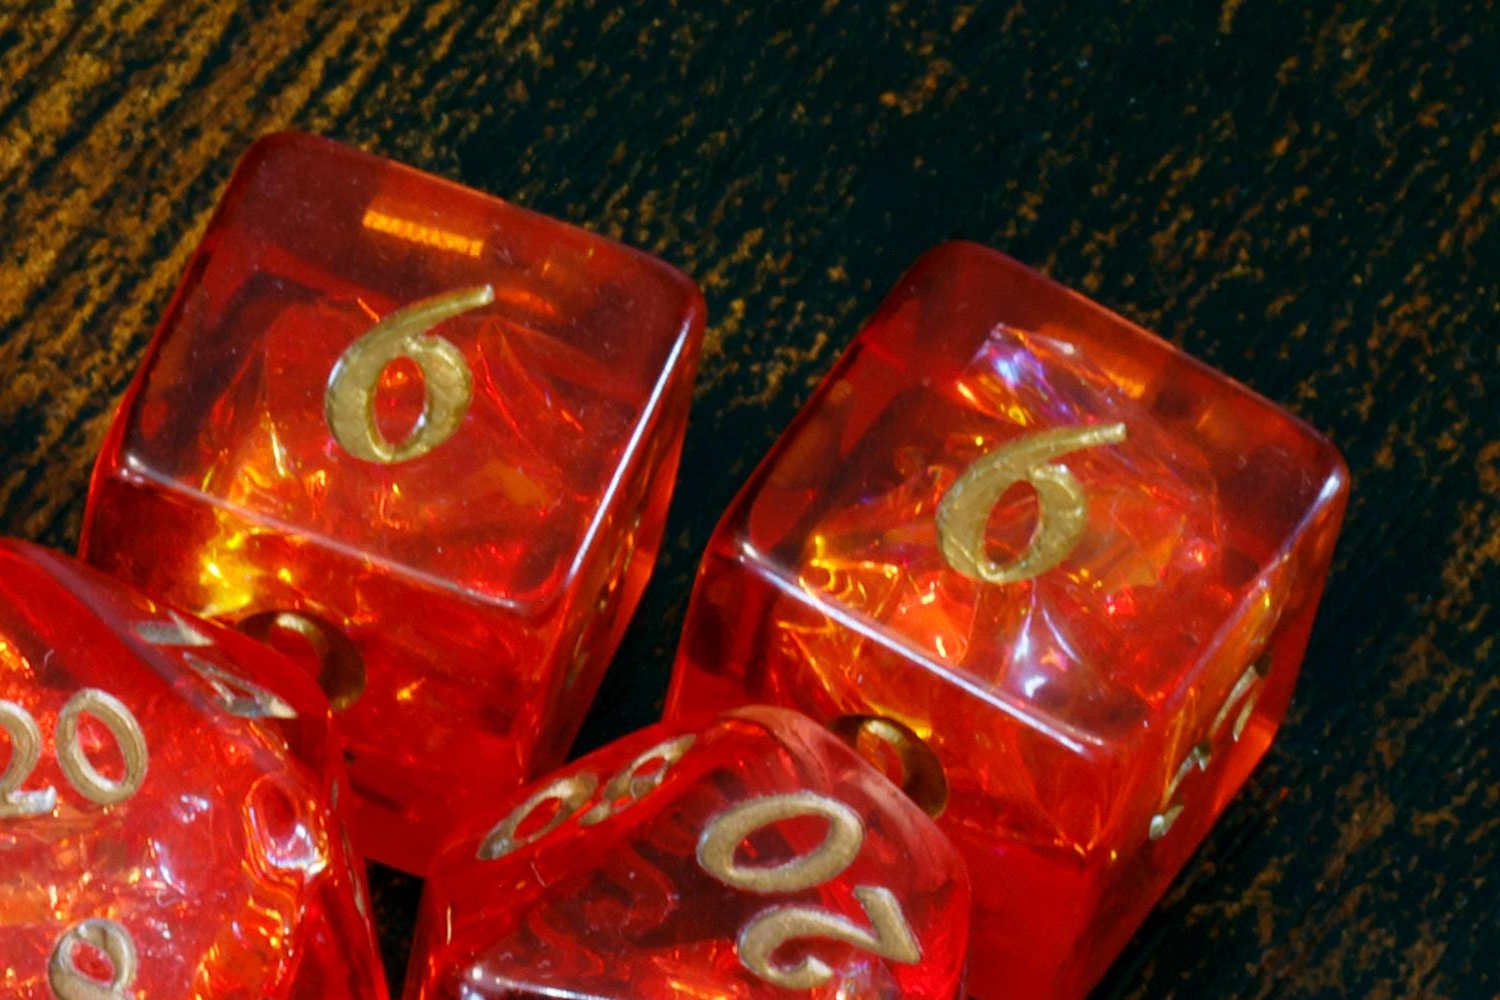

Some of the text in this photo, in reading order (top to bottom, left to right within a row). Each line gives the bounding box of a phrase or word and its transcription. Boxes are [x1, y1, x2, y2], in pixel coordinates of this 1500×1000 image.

[325, 284, 494, 463] 6
[935, 423, 1126, 583] 6
[698, 791, 921, 988] 20
